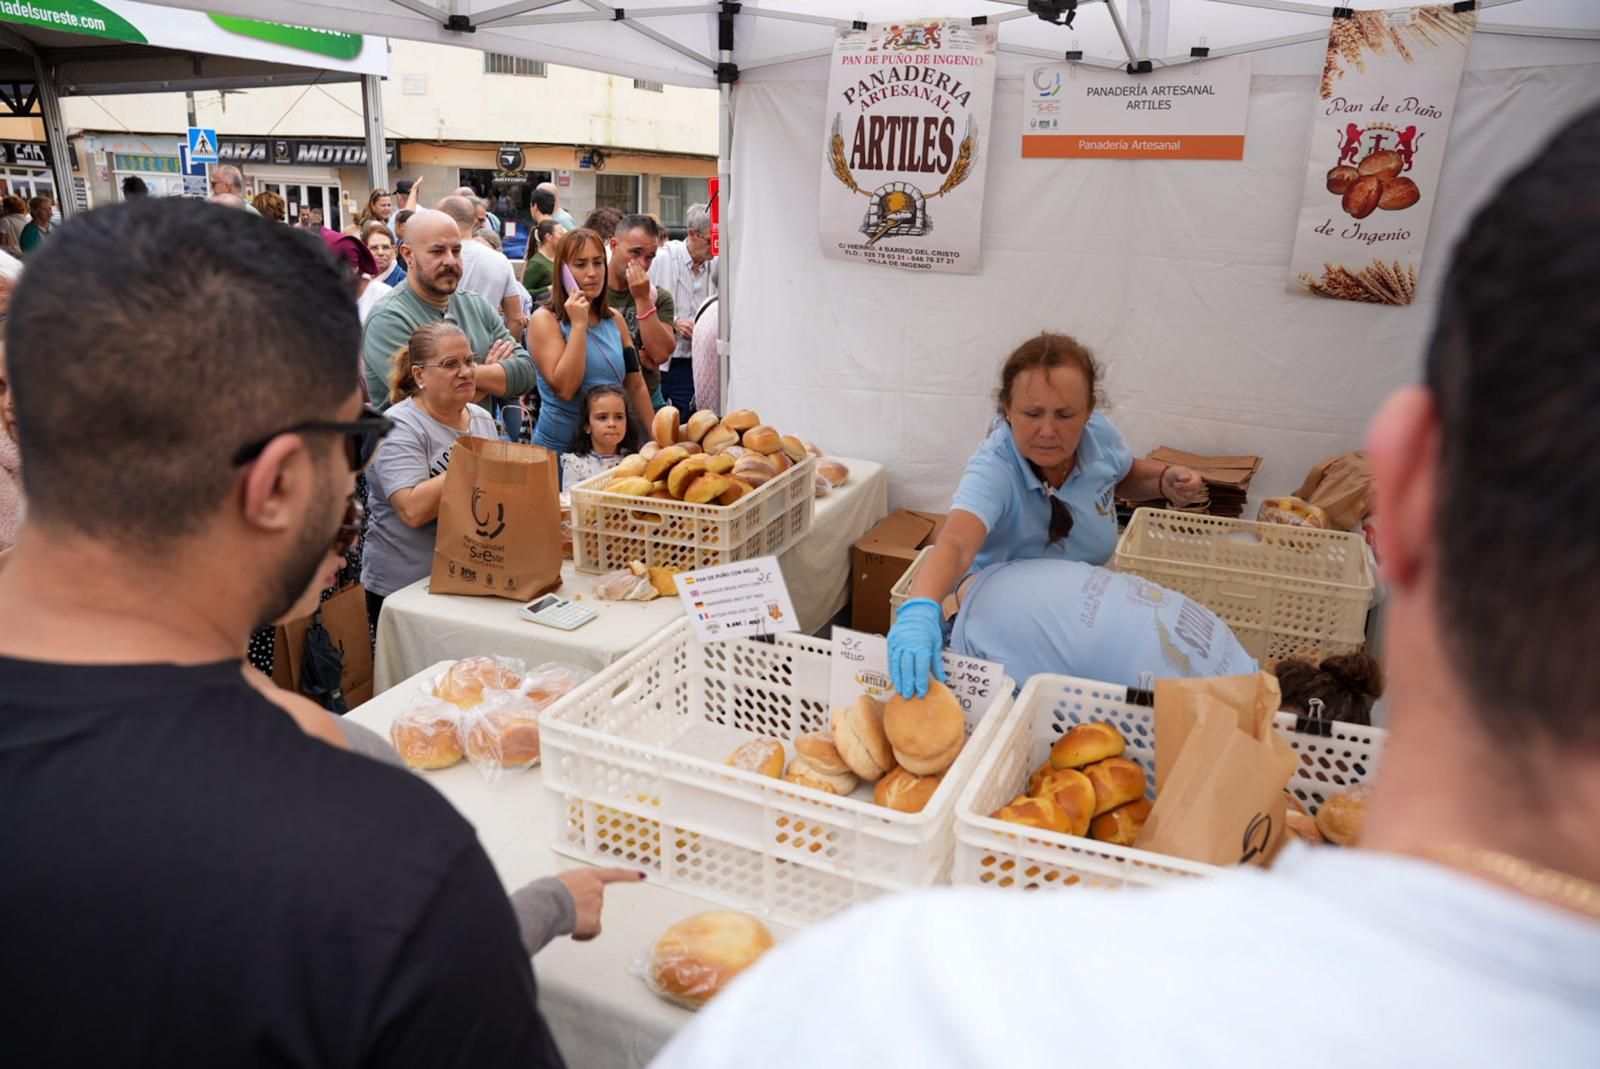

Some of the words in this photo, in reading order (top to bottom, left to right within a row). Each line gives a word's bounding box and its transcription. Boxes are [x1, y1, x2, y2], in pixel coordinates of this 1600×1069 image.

[842, 55, 861, 65] PAN
[864, 55, 879, 65] DE
[881, 52, 912, 65] PUÑO
[915, 55, 929, 65] DE
[933, 54, 984, 66] INGENIO
[842, 65, 972, 108] PANADERIA
[1087, 83, 1148, 97] PANADERÍA
[1151, 85, 1216, 96] ARTESANAL
[859, 84, 951, 114] ARTESANAL
[1126, 100, 1172, 111] ARTILES
[1325, 97, 1363, 116] Pan
[1370, 95, 1389, 112] de
[1395, 96, 1442, 119] Puño
[14, 144, 45, 160] CAR
[850, 115, 955, 175] ARTILES
[1078, 139, 1128, 151] Panadería
[1131, 140, 1181, 151] Artesanal
[1314, 219, 1334, 236] de
[1341, 222, 1411, 246] Ingenio
[884, 246, 913, 255] BARRIO
[915, 248, 929, 256] DEL
[931, 250, 960, 258] CRISTO
[900, 261, 932, 270] INGENIO
